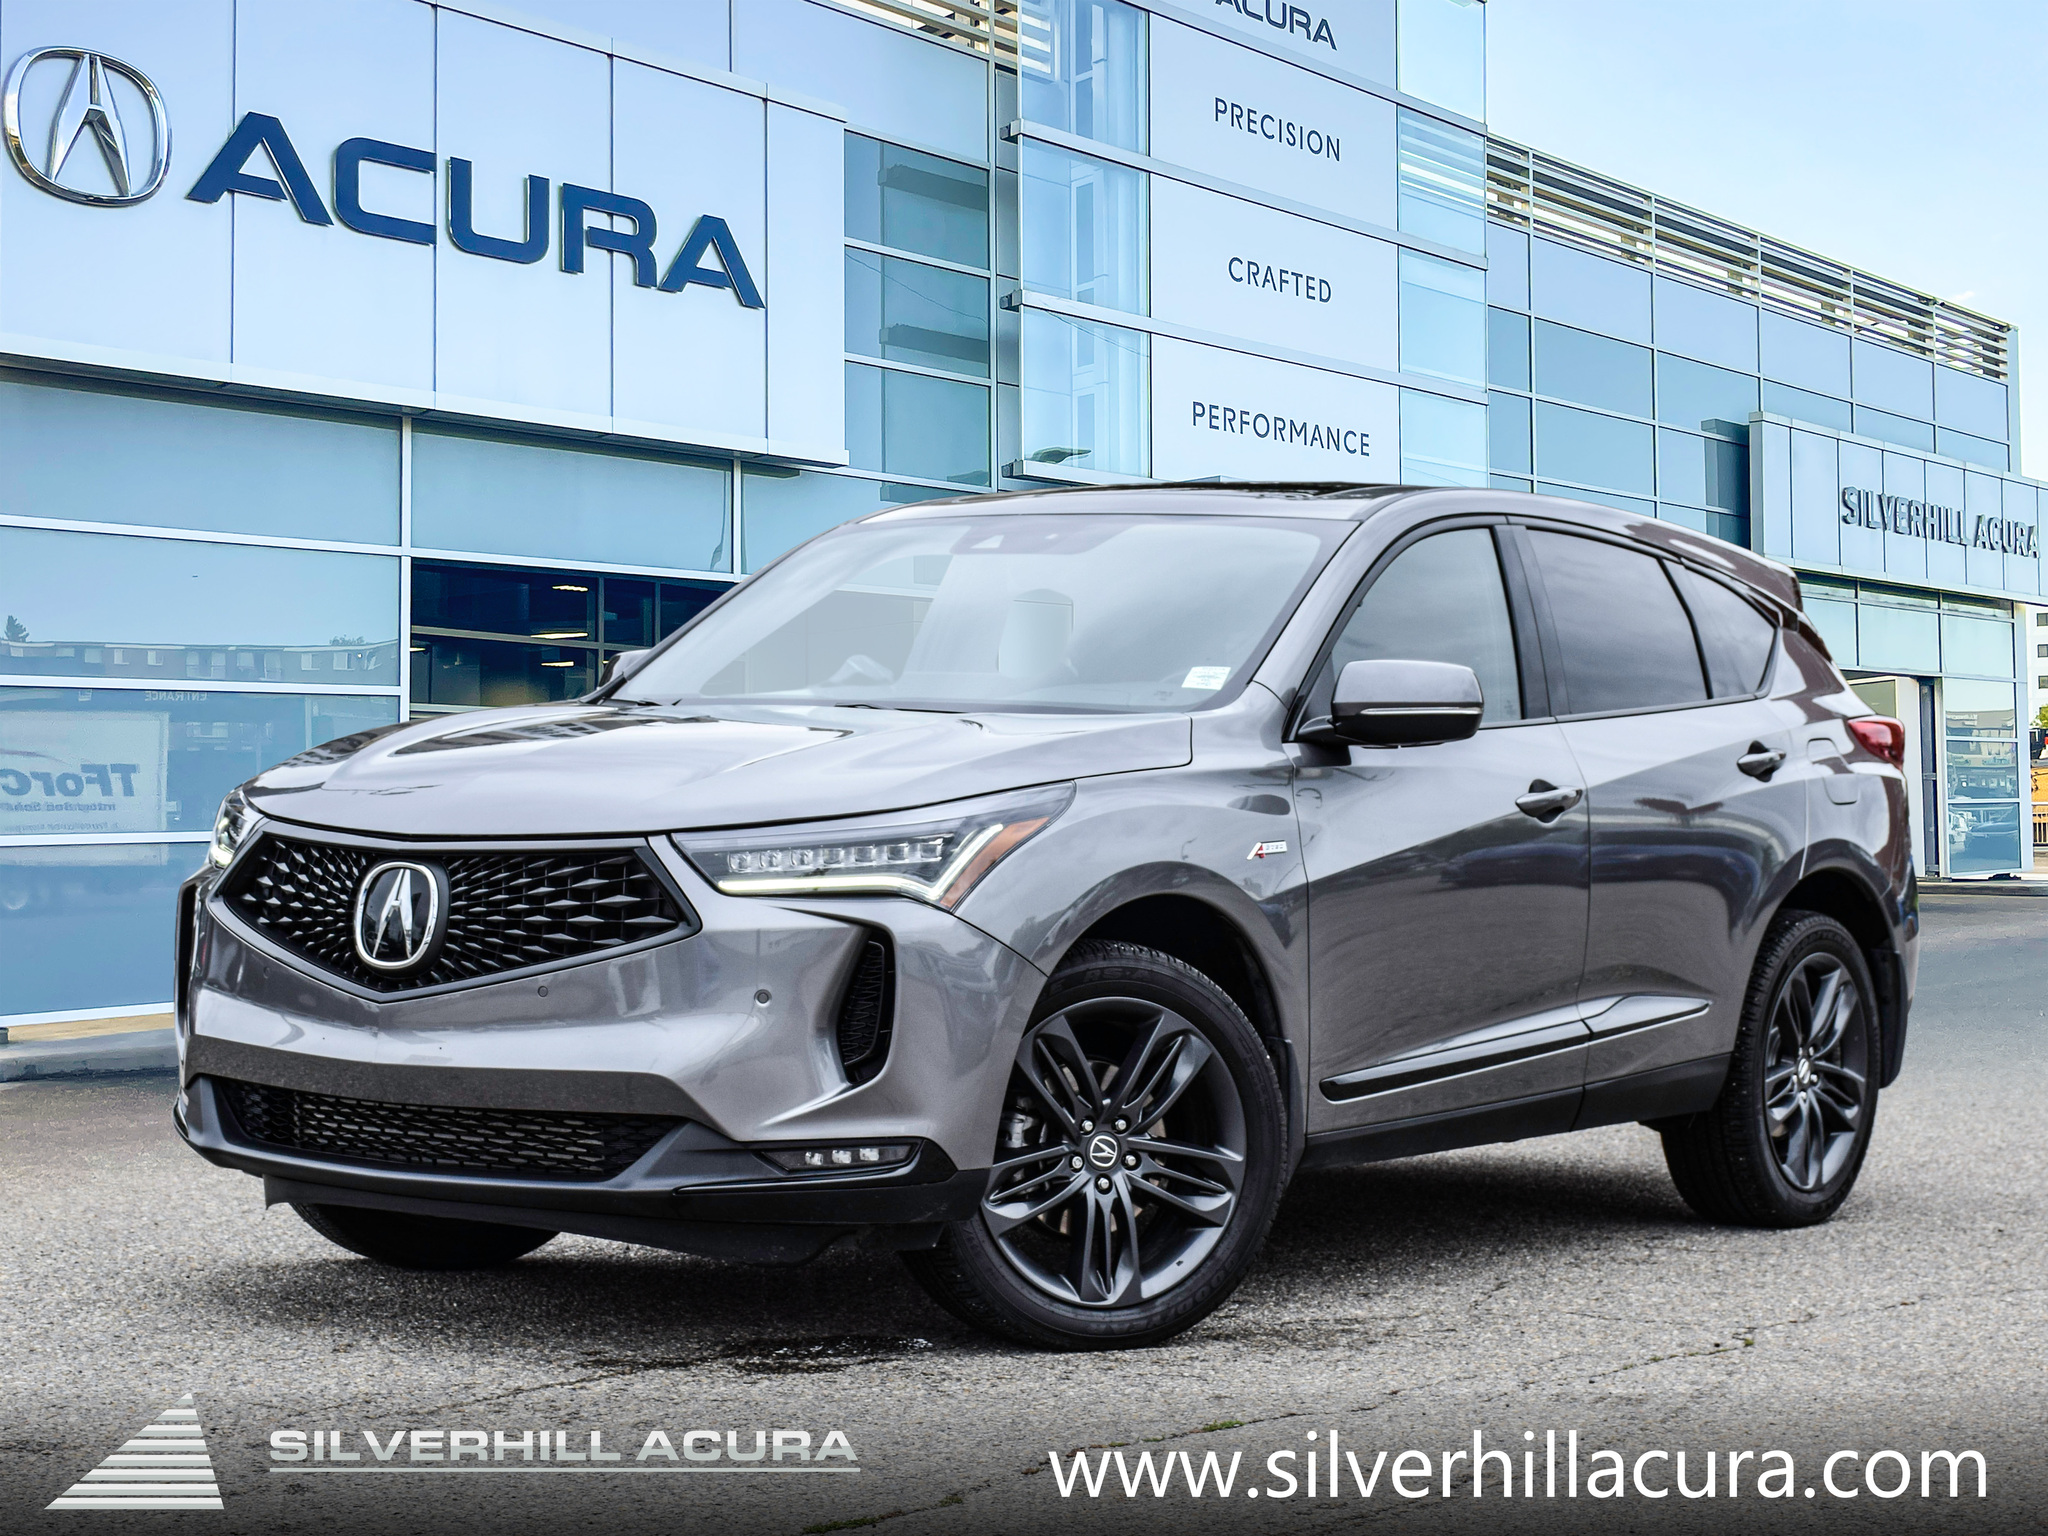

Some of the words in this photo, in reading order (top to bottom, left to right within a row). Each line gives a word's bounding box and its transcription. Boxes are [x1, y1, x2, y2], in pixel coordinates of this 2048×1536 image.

[1214, 97, 1341, 162] PRECISION
[186, 111, 767, 310] ACURA
[1228, 256, 1333, 304] CRAFTED
[1192, 401, 1370, 457] PERFORMANCE
[1841, 486, 1972, 546] SILVERHILL
[1974, 514, 2041, 559] ACURA
